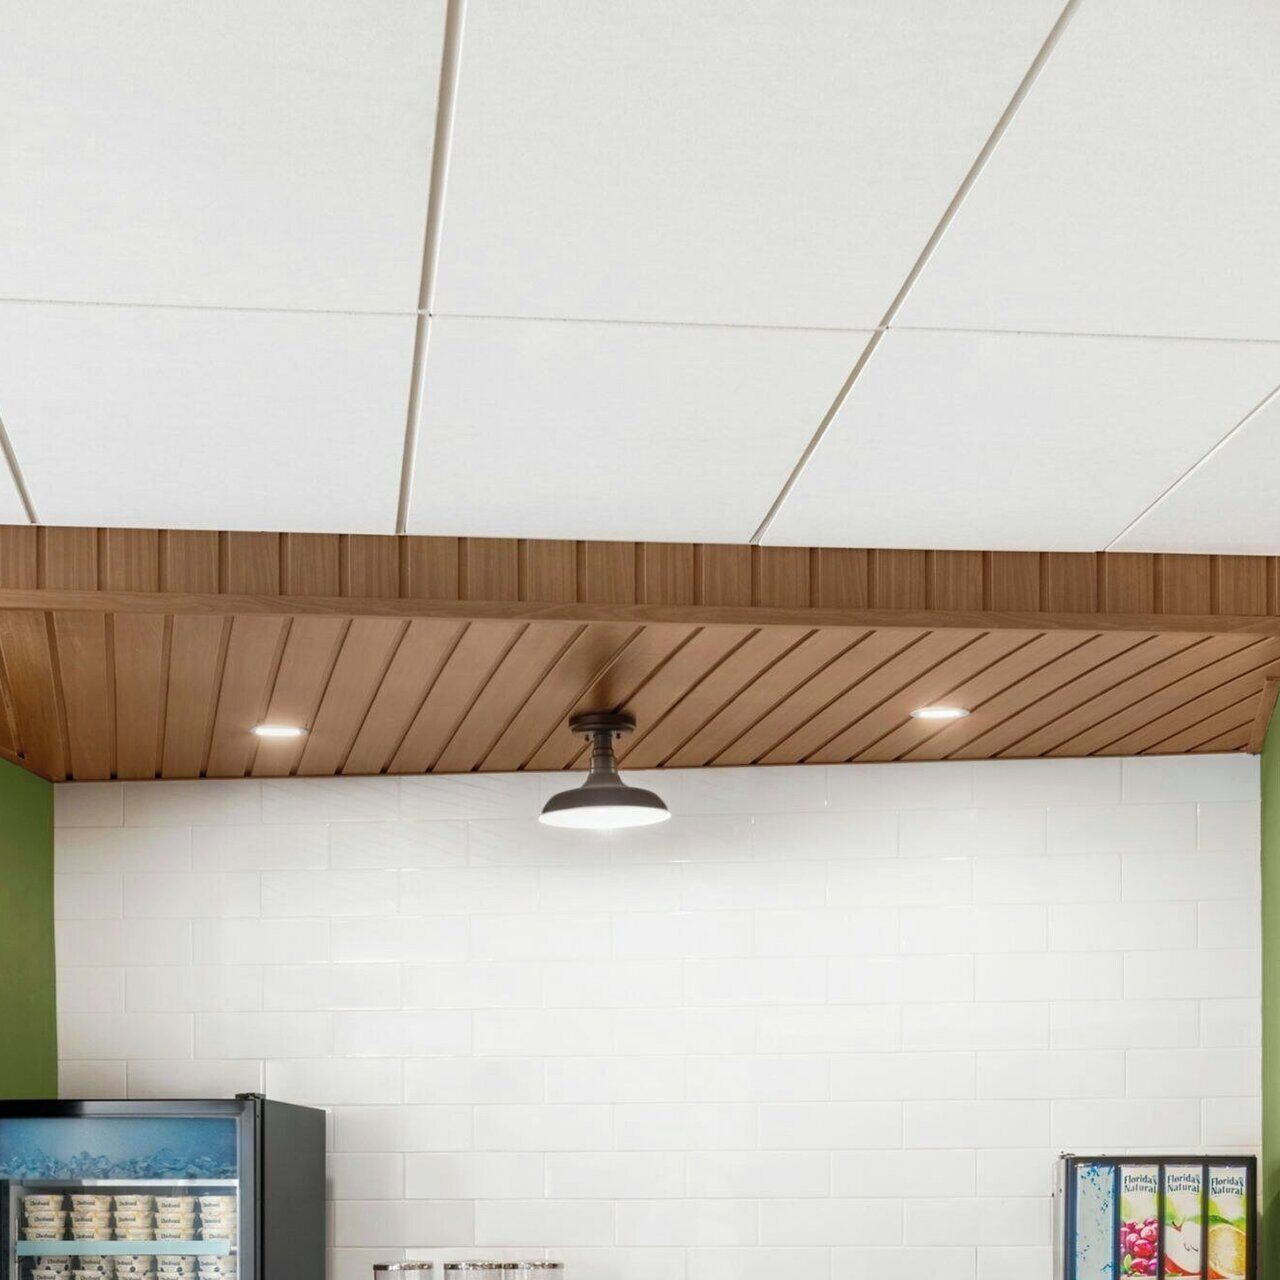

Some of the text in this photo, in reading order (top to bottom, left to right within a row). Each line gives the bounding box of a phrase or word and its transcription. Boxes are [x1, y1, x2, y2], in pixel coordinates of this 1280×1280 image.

[1124, 1184, 1156, 1193] Natural
[1167, 1183, 1200, 1193] Natural
[1211, 1185, 1243, 1195] Natural
